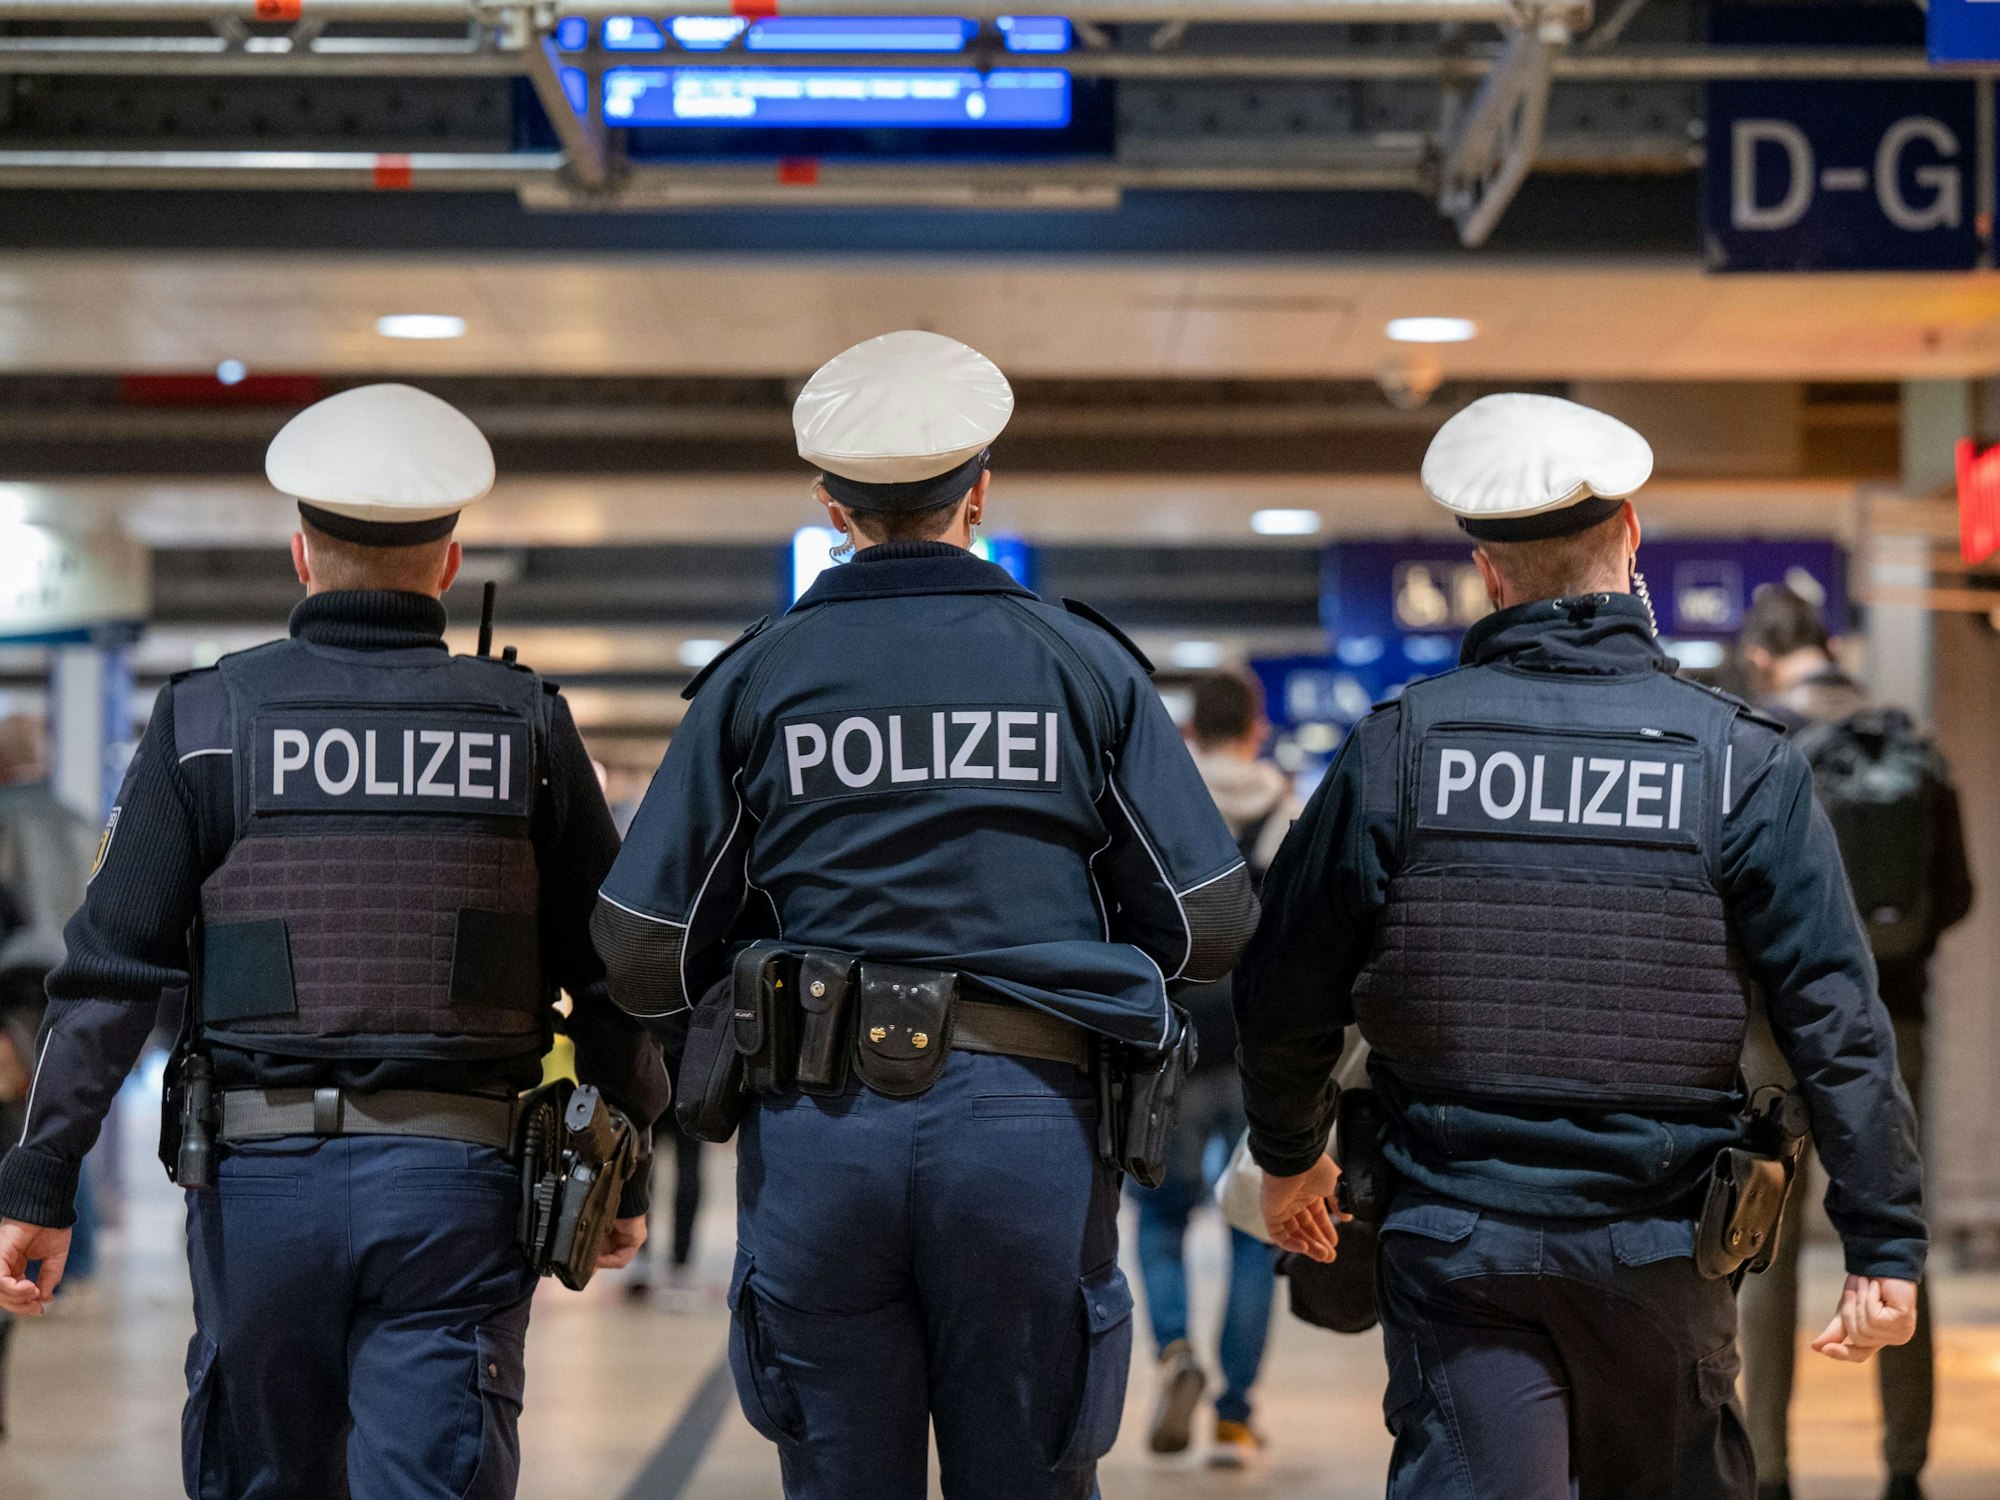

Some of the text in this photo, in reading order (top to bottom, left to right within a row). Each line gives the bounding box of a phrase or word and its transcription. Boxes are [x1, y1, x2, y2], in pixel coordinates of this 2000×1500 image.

[1730, 116, 1962, 231] D-G
[273, 728, 511, 800] POLIZEI
[784, 711, 1058, 796] POLIZEI
[1436, 748, 1684, 829] POLIZEI
